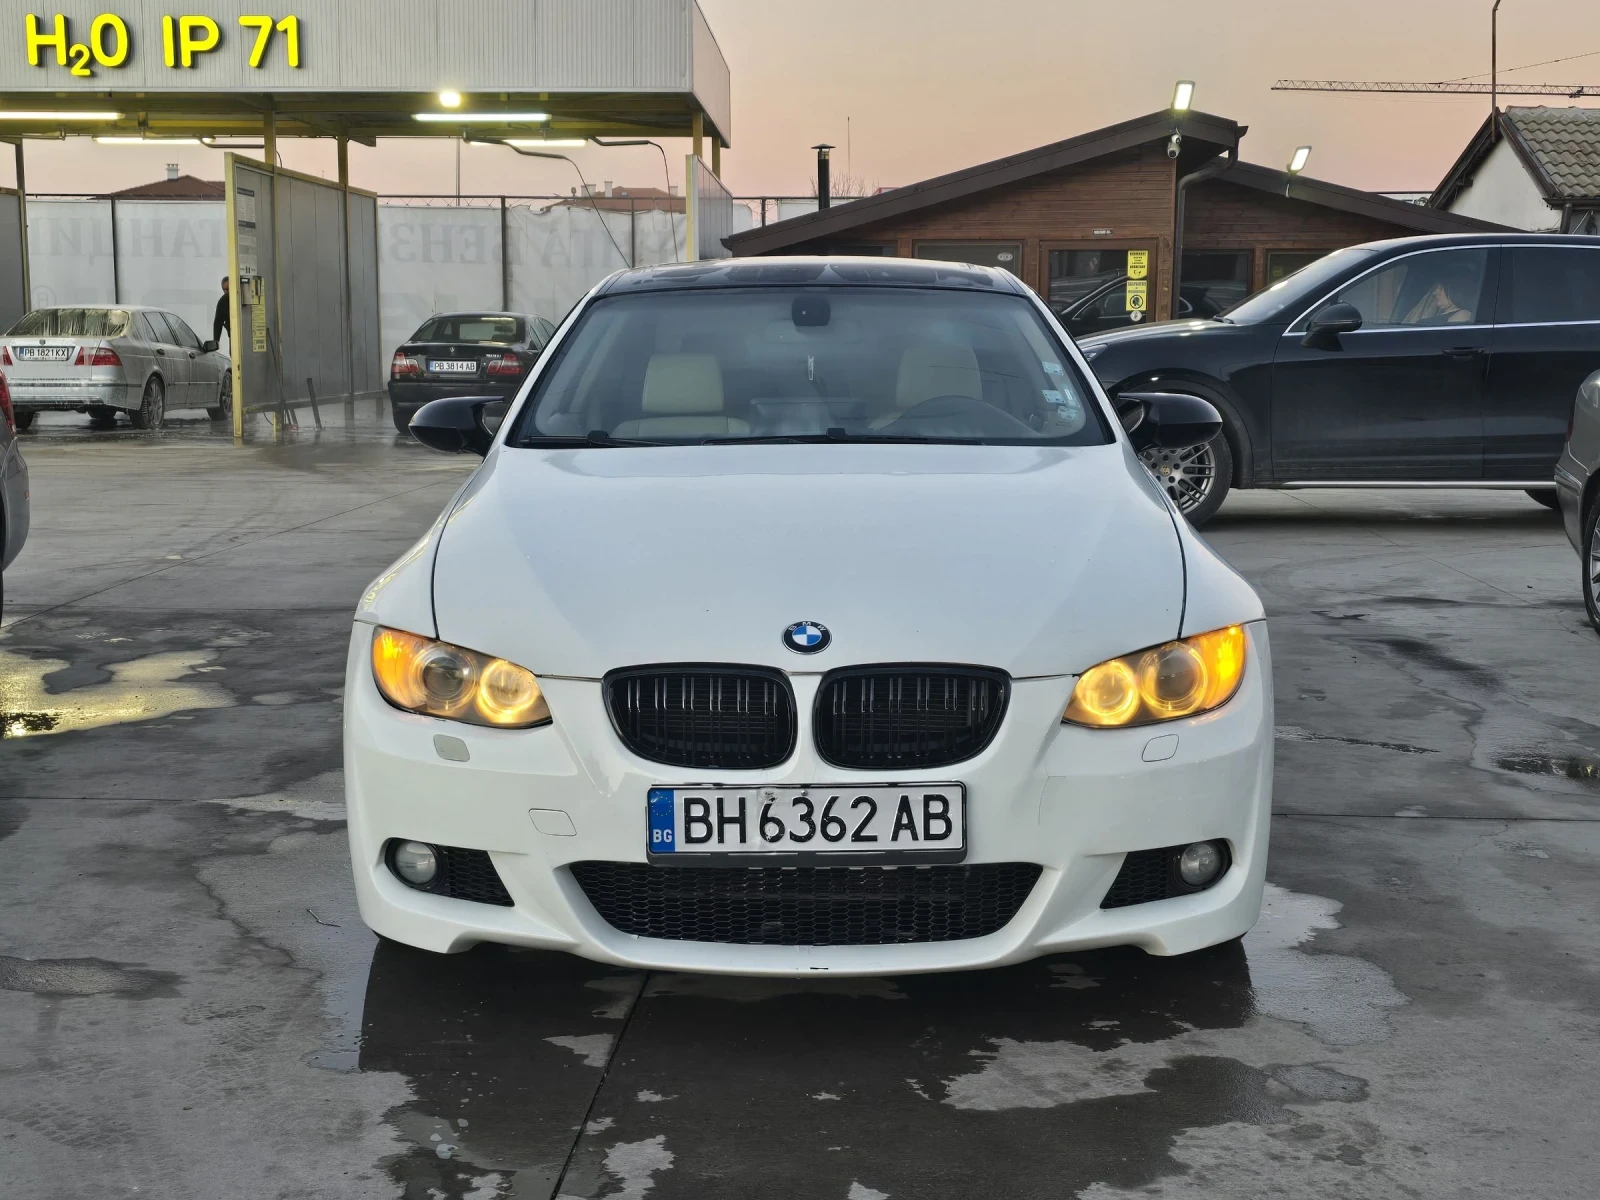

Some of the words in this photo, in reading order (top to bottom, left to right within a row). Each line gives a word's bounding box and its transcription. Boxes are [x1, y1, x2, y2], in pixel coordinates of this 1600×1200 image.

[162, 15, 220, 67] IP
[238, 15, 299, 67] 71
[24, 348, 34, 357] PB
[37, 348, 54, 357] 1821
[55, 348, 66, 357] KX
[445, 362, 464, 371] 3814
[683, 797, 747, 844] BH
[759, 795, 879, 843] 6362
[890, 794, 953, 841] AB
[652, 828, 673, 843] BG
